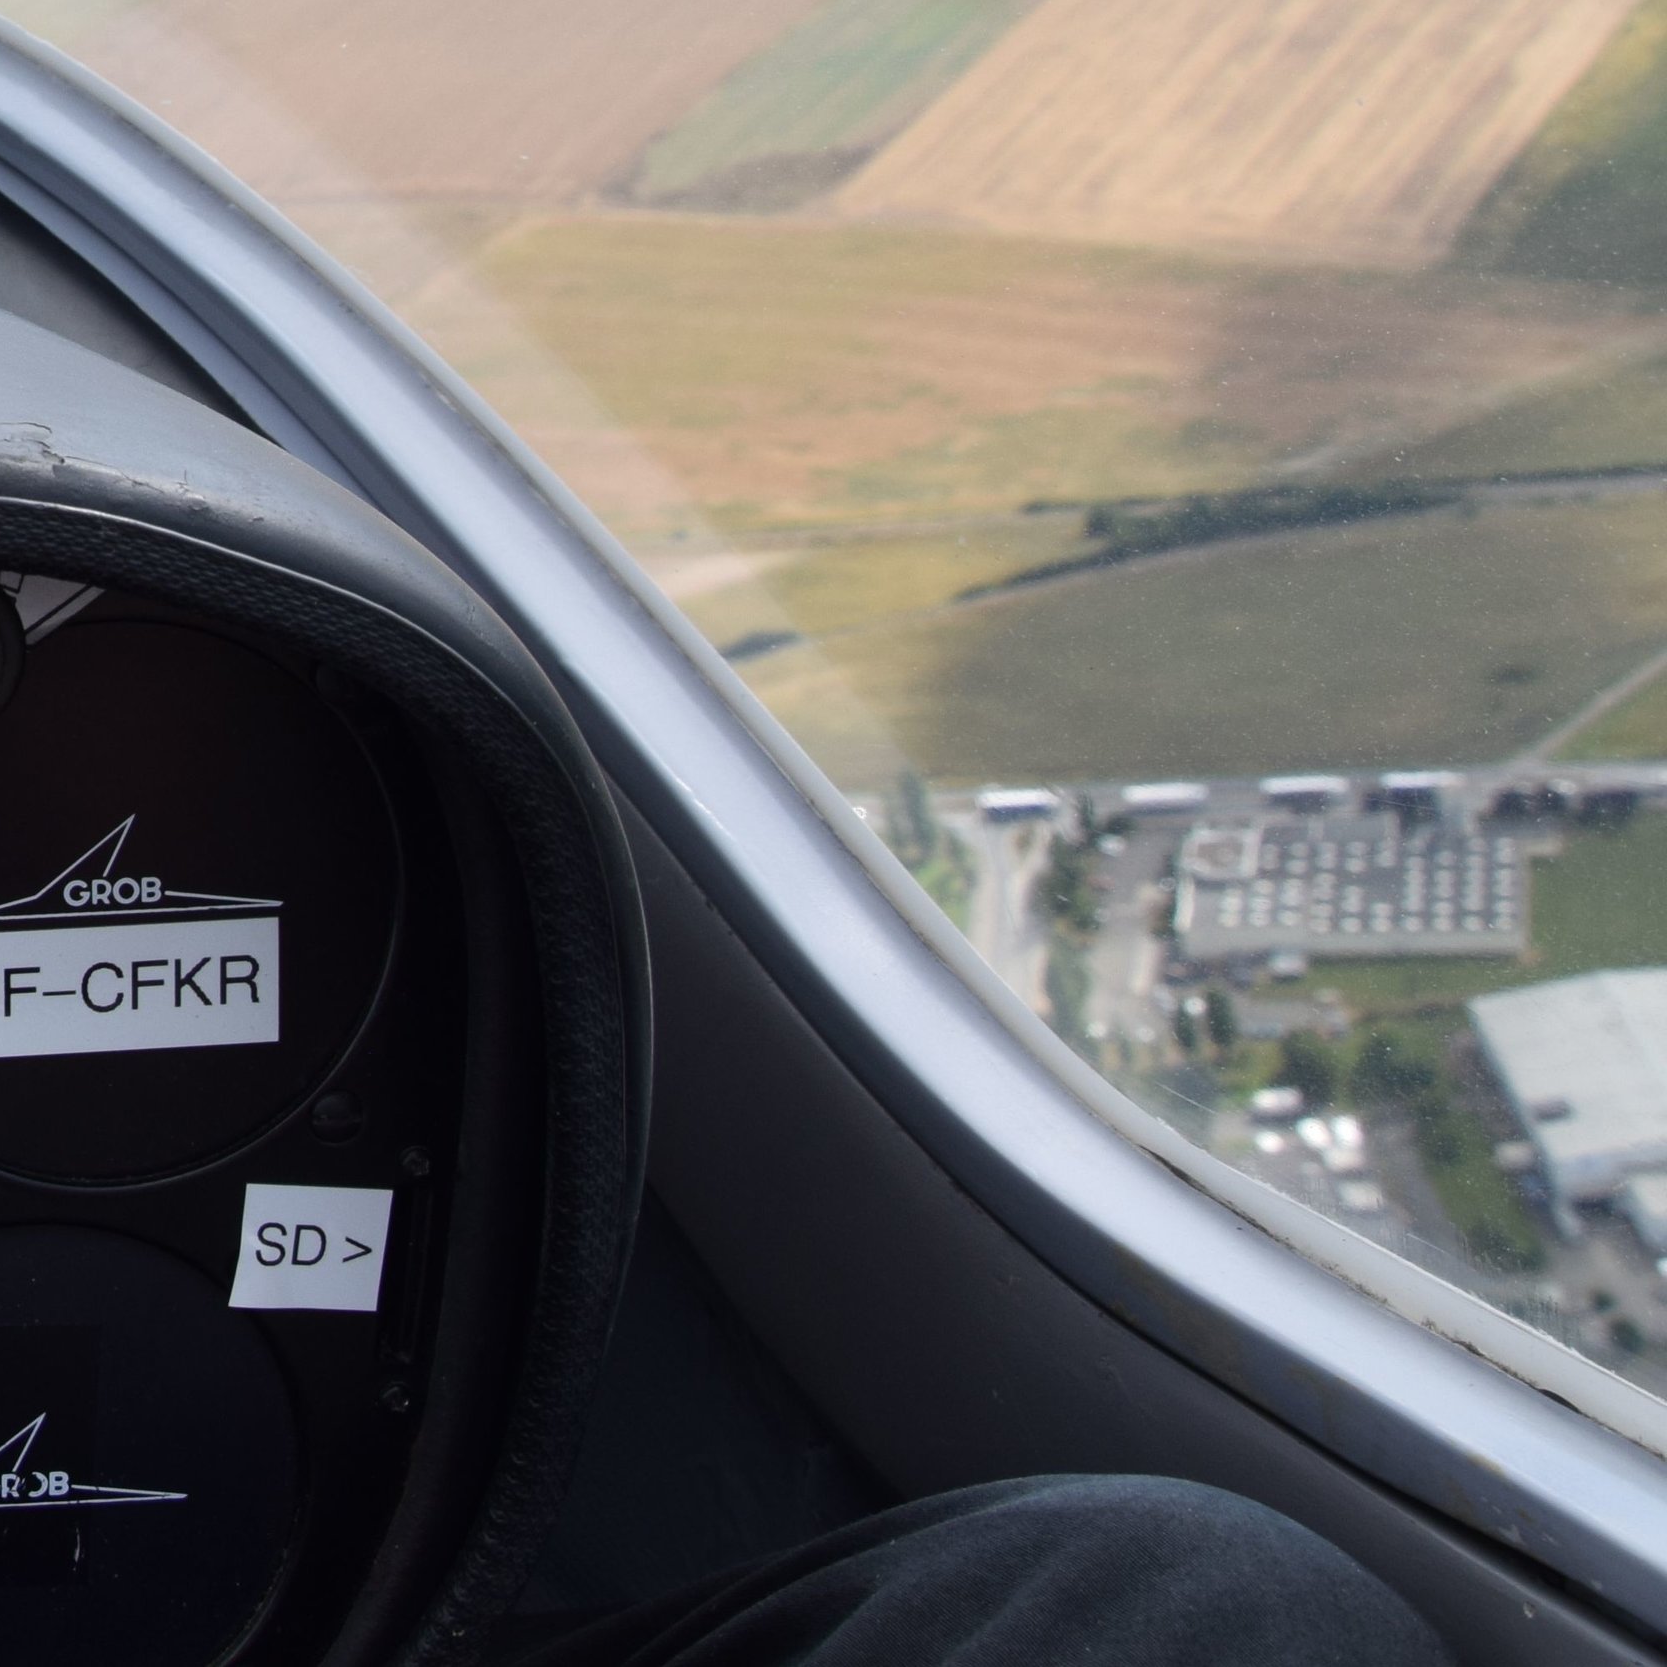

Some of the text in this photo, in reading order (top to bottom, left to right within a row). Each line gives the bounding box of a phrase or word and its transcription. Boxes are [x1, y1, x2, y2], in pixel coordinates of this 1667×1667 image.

[62, 876, 163, 907] GROB
[0, 954, 261, 1018] F-CFKR
[254, 1222, 328, 1268] SD
